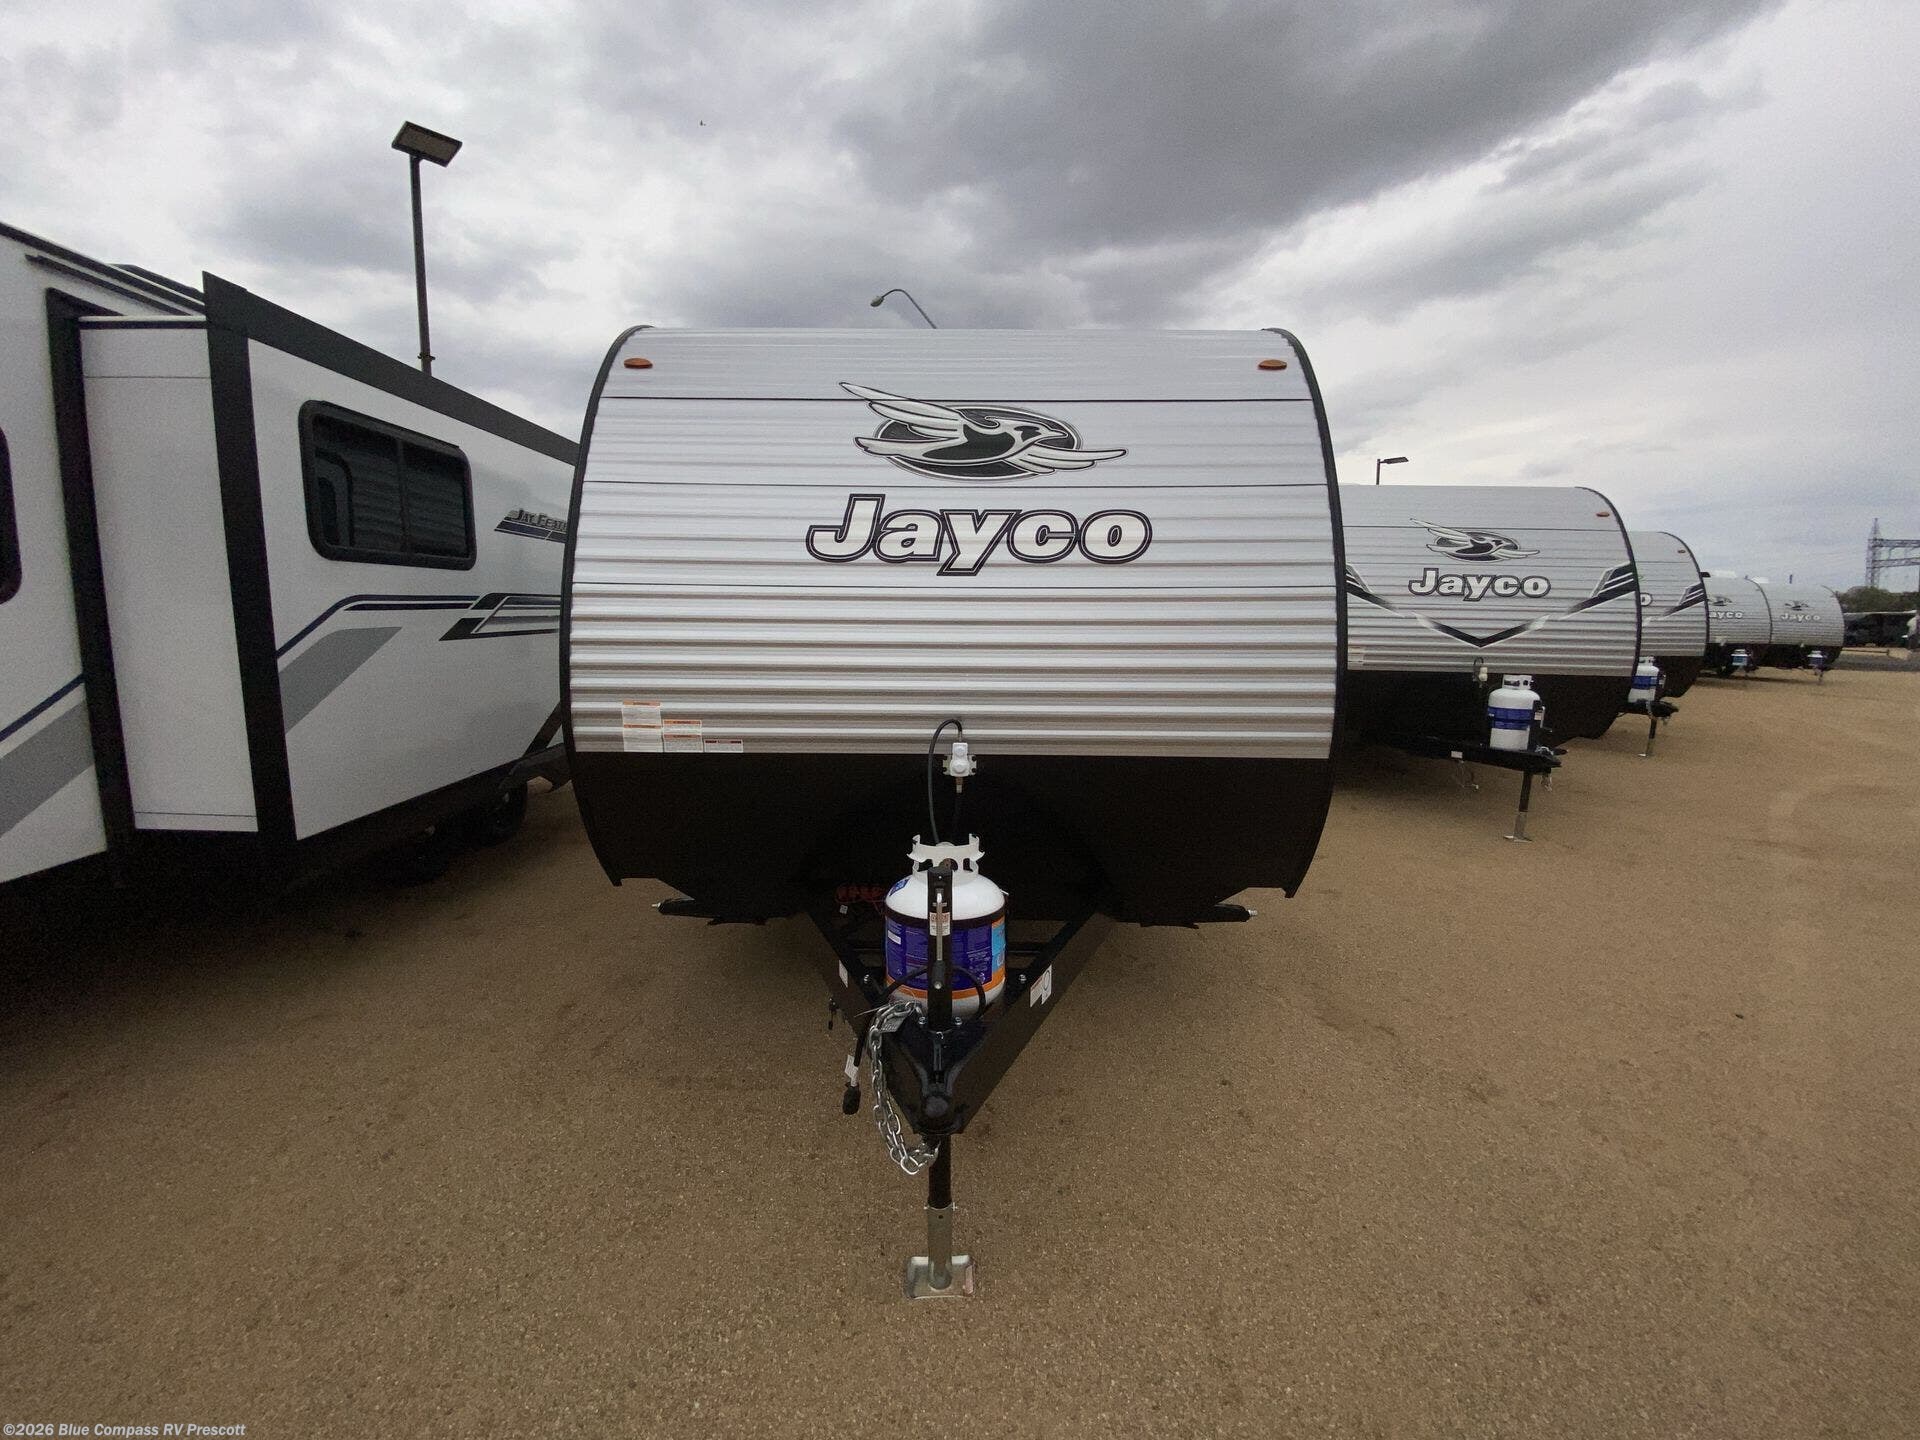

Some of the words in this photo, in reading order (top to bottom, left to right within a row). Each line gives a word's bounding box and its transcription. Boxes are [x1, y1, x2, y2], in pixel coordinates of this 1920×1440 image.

[806, 494, 1153, 576] Jayco
[1408, 567, 1551, 602] Jayco
[1708, 610, 1743, 619] ayco
[1781, 613, 1821, 622] Jayco
